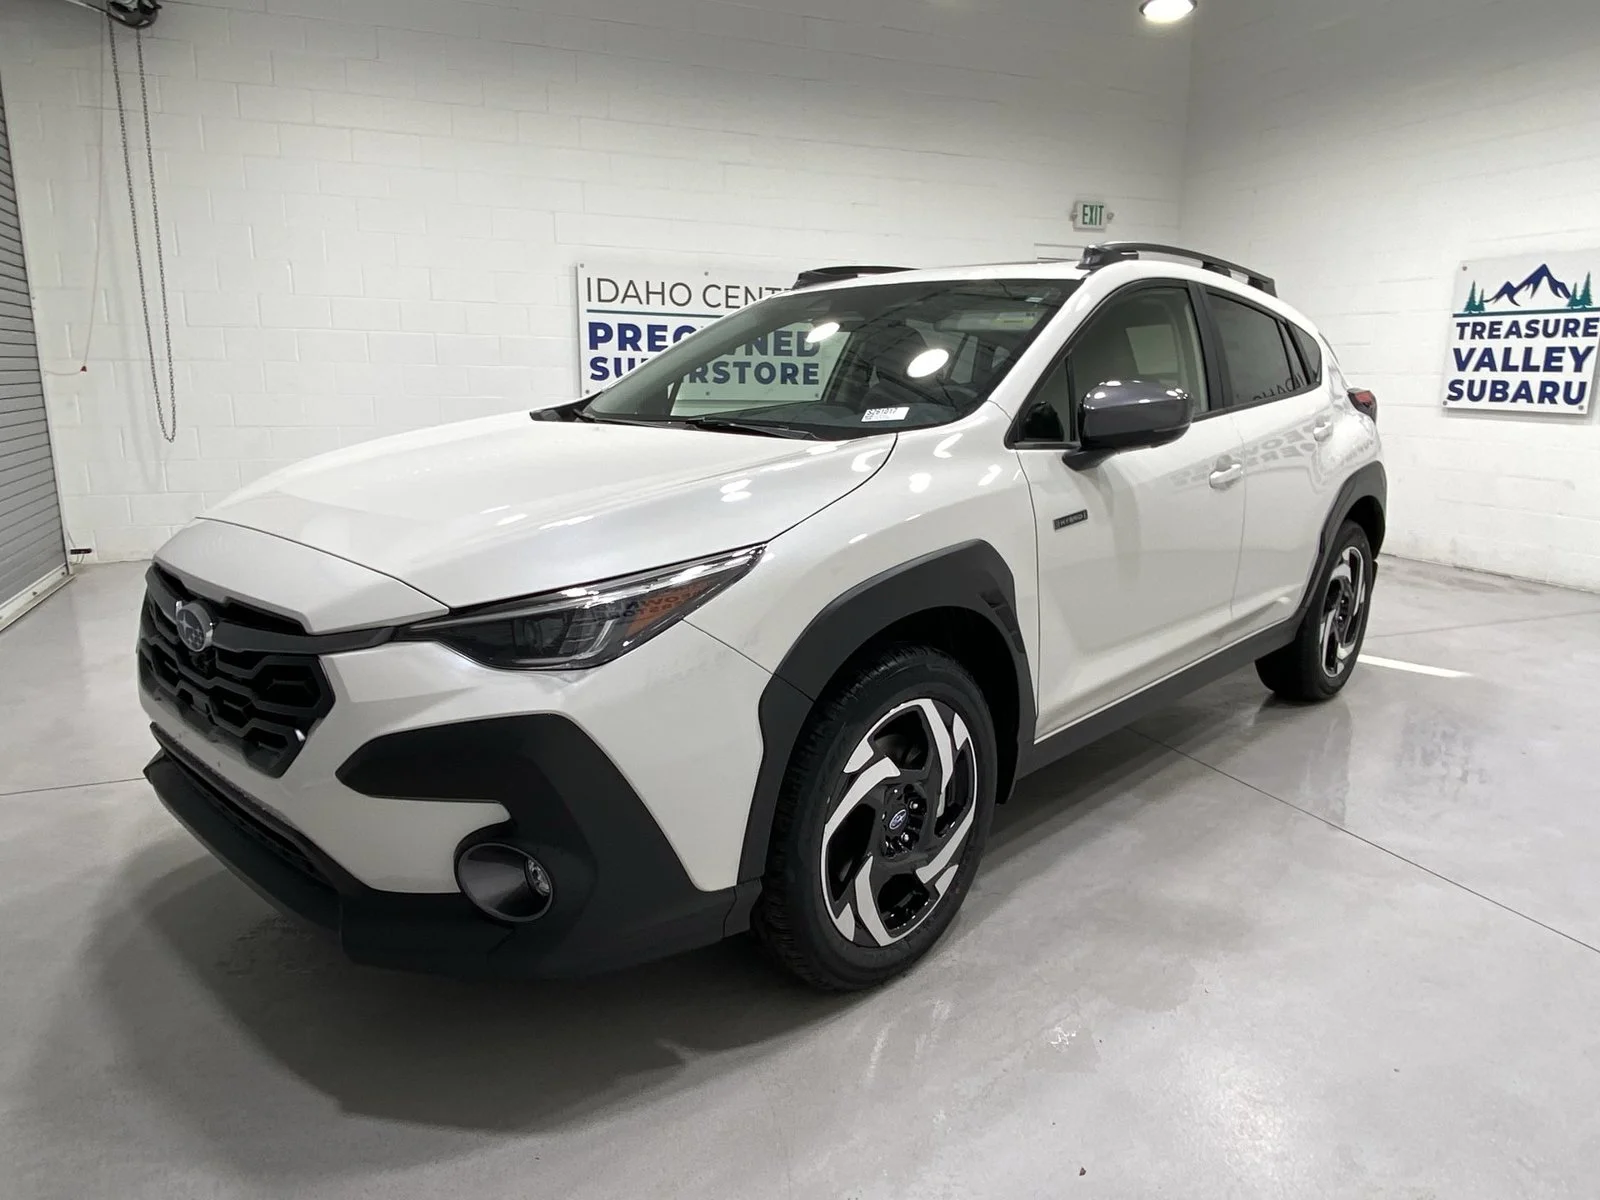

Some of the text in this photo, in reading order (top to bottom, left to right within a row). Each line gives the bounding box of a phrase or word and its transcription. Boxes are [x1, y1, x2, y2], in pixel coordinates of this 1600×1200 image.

[1083, 204, 1104, 226] EXIT
[586, 276, 793, 309] IDAHO CENT
[1456, 317, 1600, 340] TREASURE
[589, 355, 820, 386] SURSTORE
[1452, 346, 1596, 373] VALLEY
[1447, 379, 1588, 406] SUBARU
